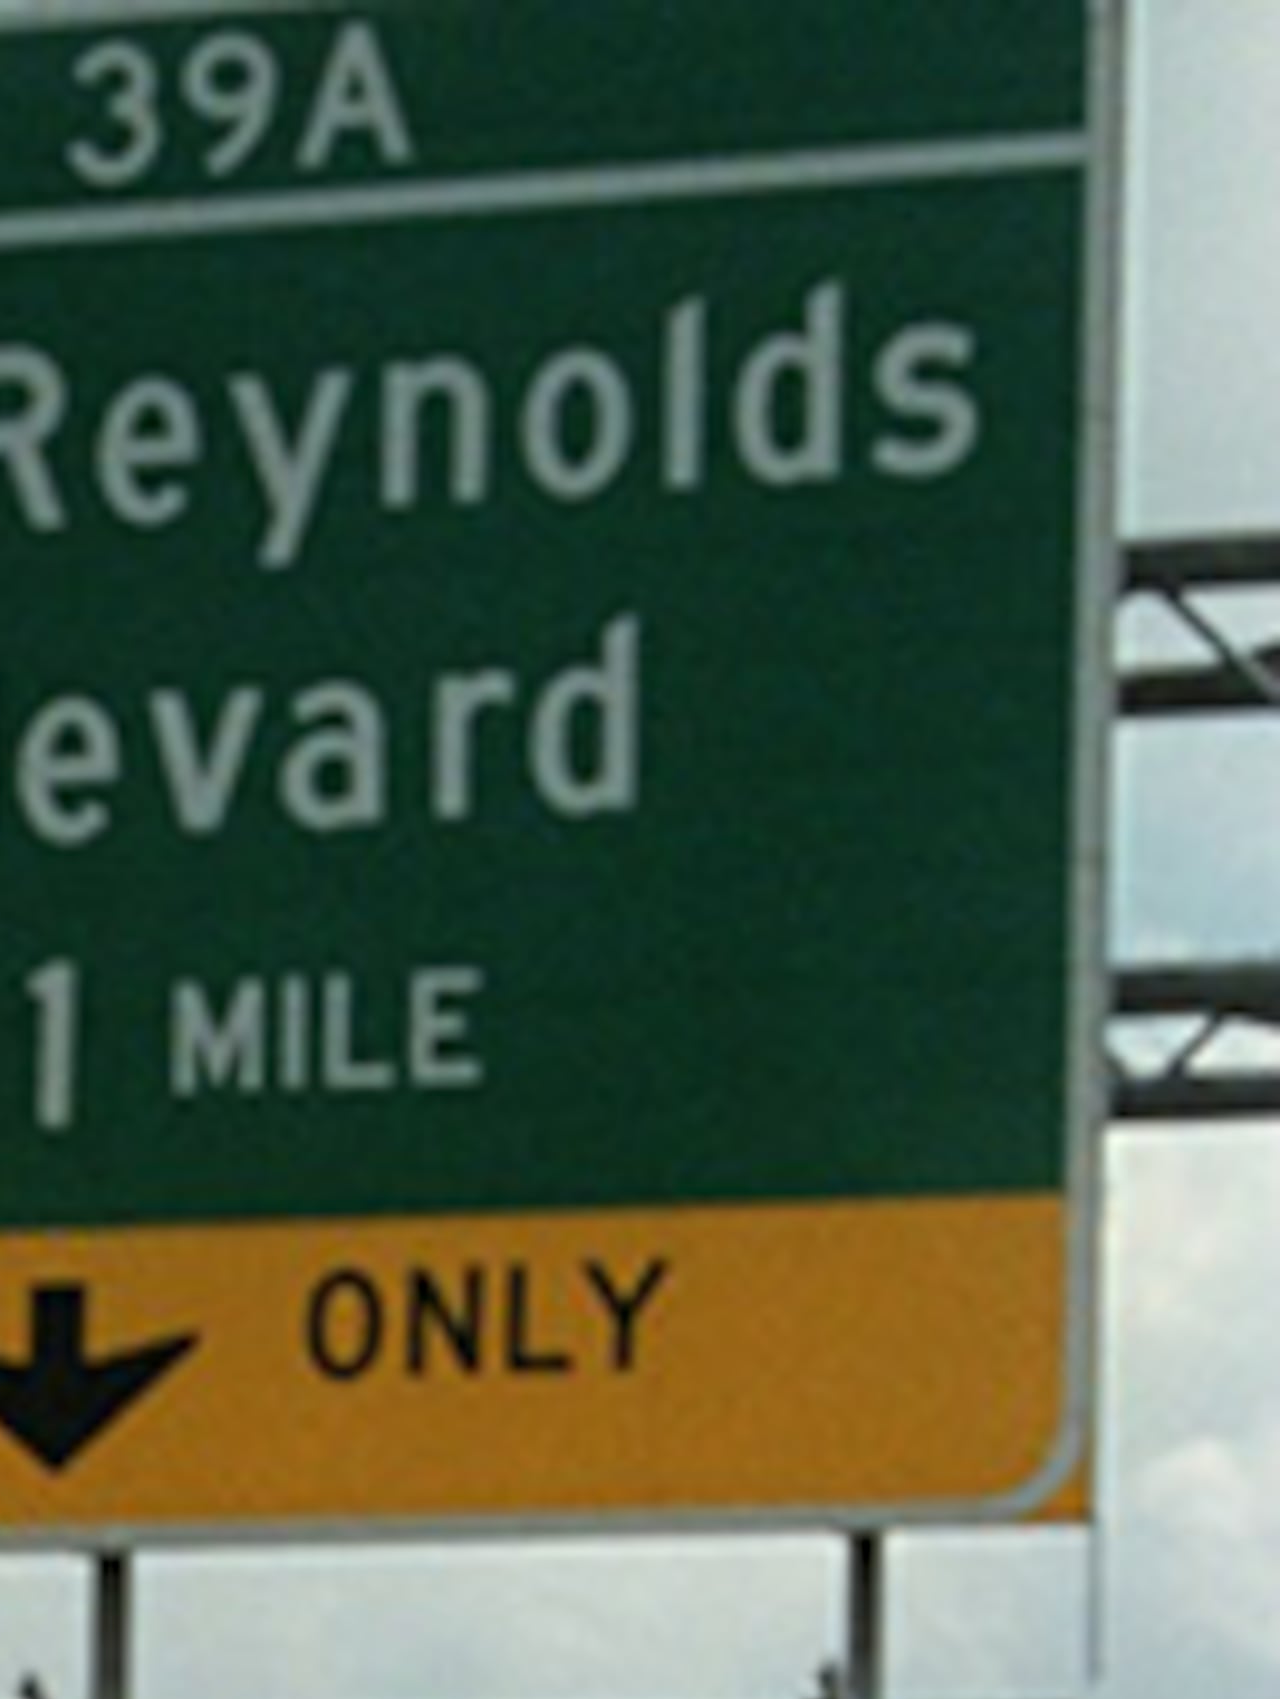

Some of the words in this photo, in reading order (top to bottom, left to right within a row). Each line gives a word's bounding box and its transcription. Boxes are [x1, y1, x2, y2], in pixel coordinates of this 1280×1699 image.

[68, 16, 412, 186] 39A
[27, 959, 76, 1129] 1
[170, 966, 482, 1096] MILE
[304, 1256, 670, 1384] ONLY
